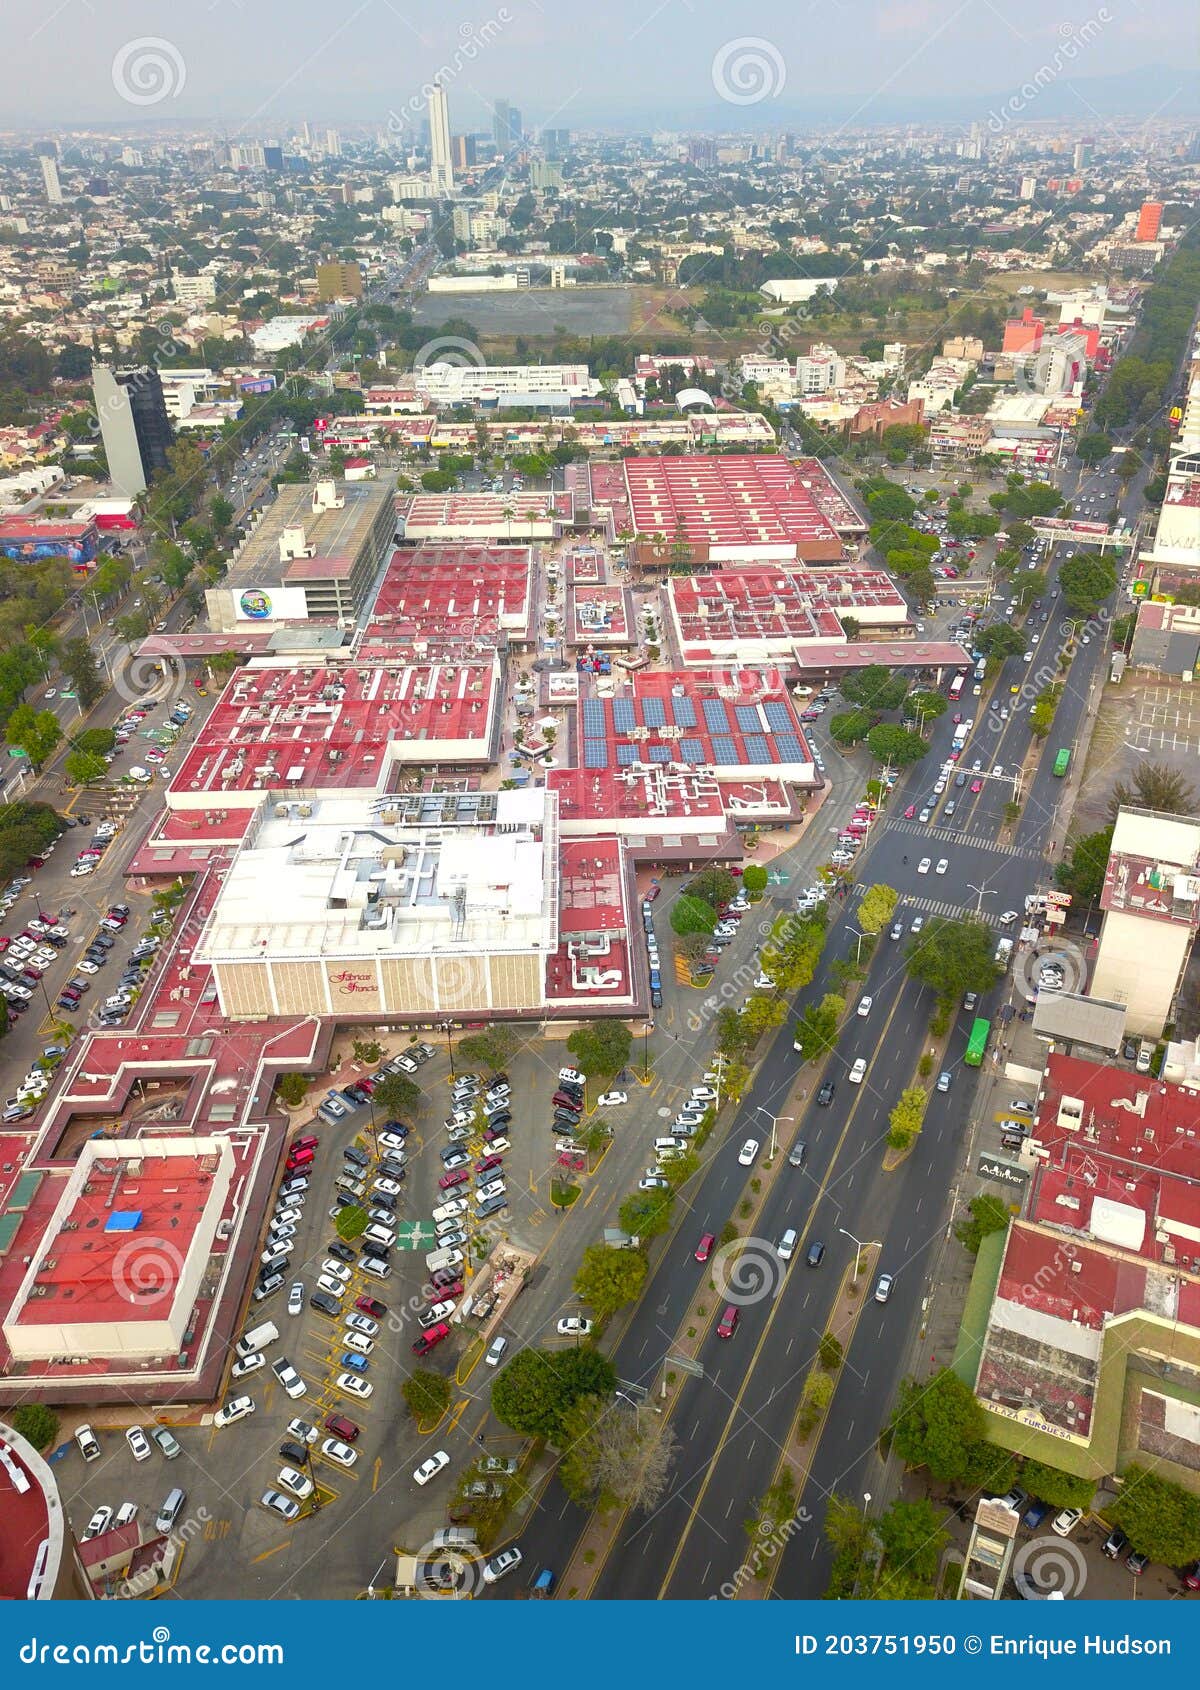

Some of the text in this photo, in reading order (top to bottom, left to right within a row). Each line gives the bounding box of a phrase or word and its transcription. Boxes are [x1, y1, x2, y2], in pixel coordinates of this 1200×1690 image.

[1048, 893, 1073, 905] OXXO
[988, 1403, 1072, 1441] PLAZA TURQUESA
